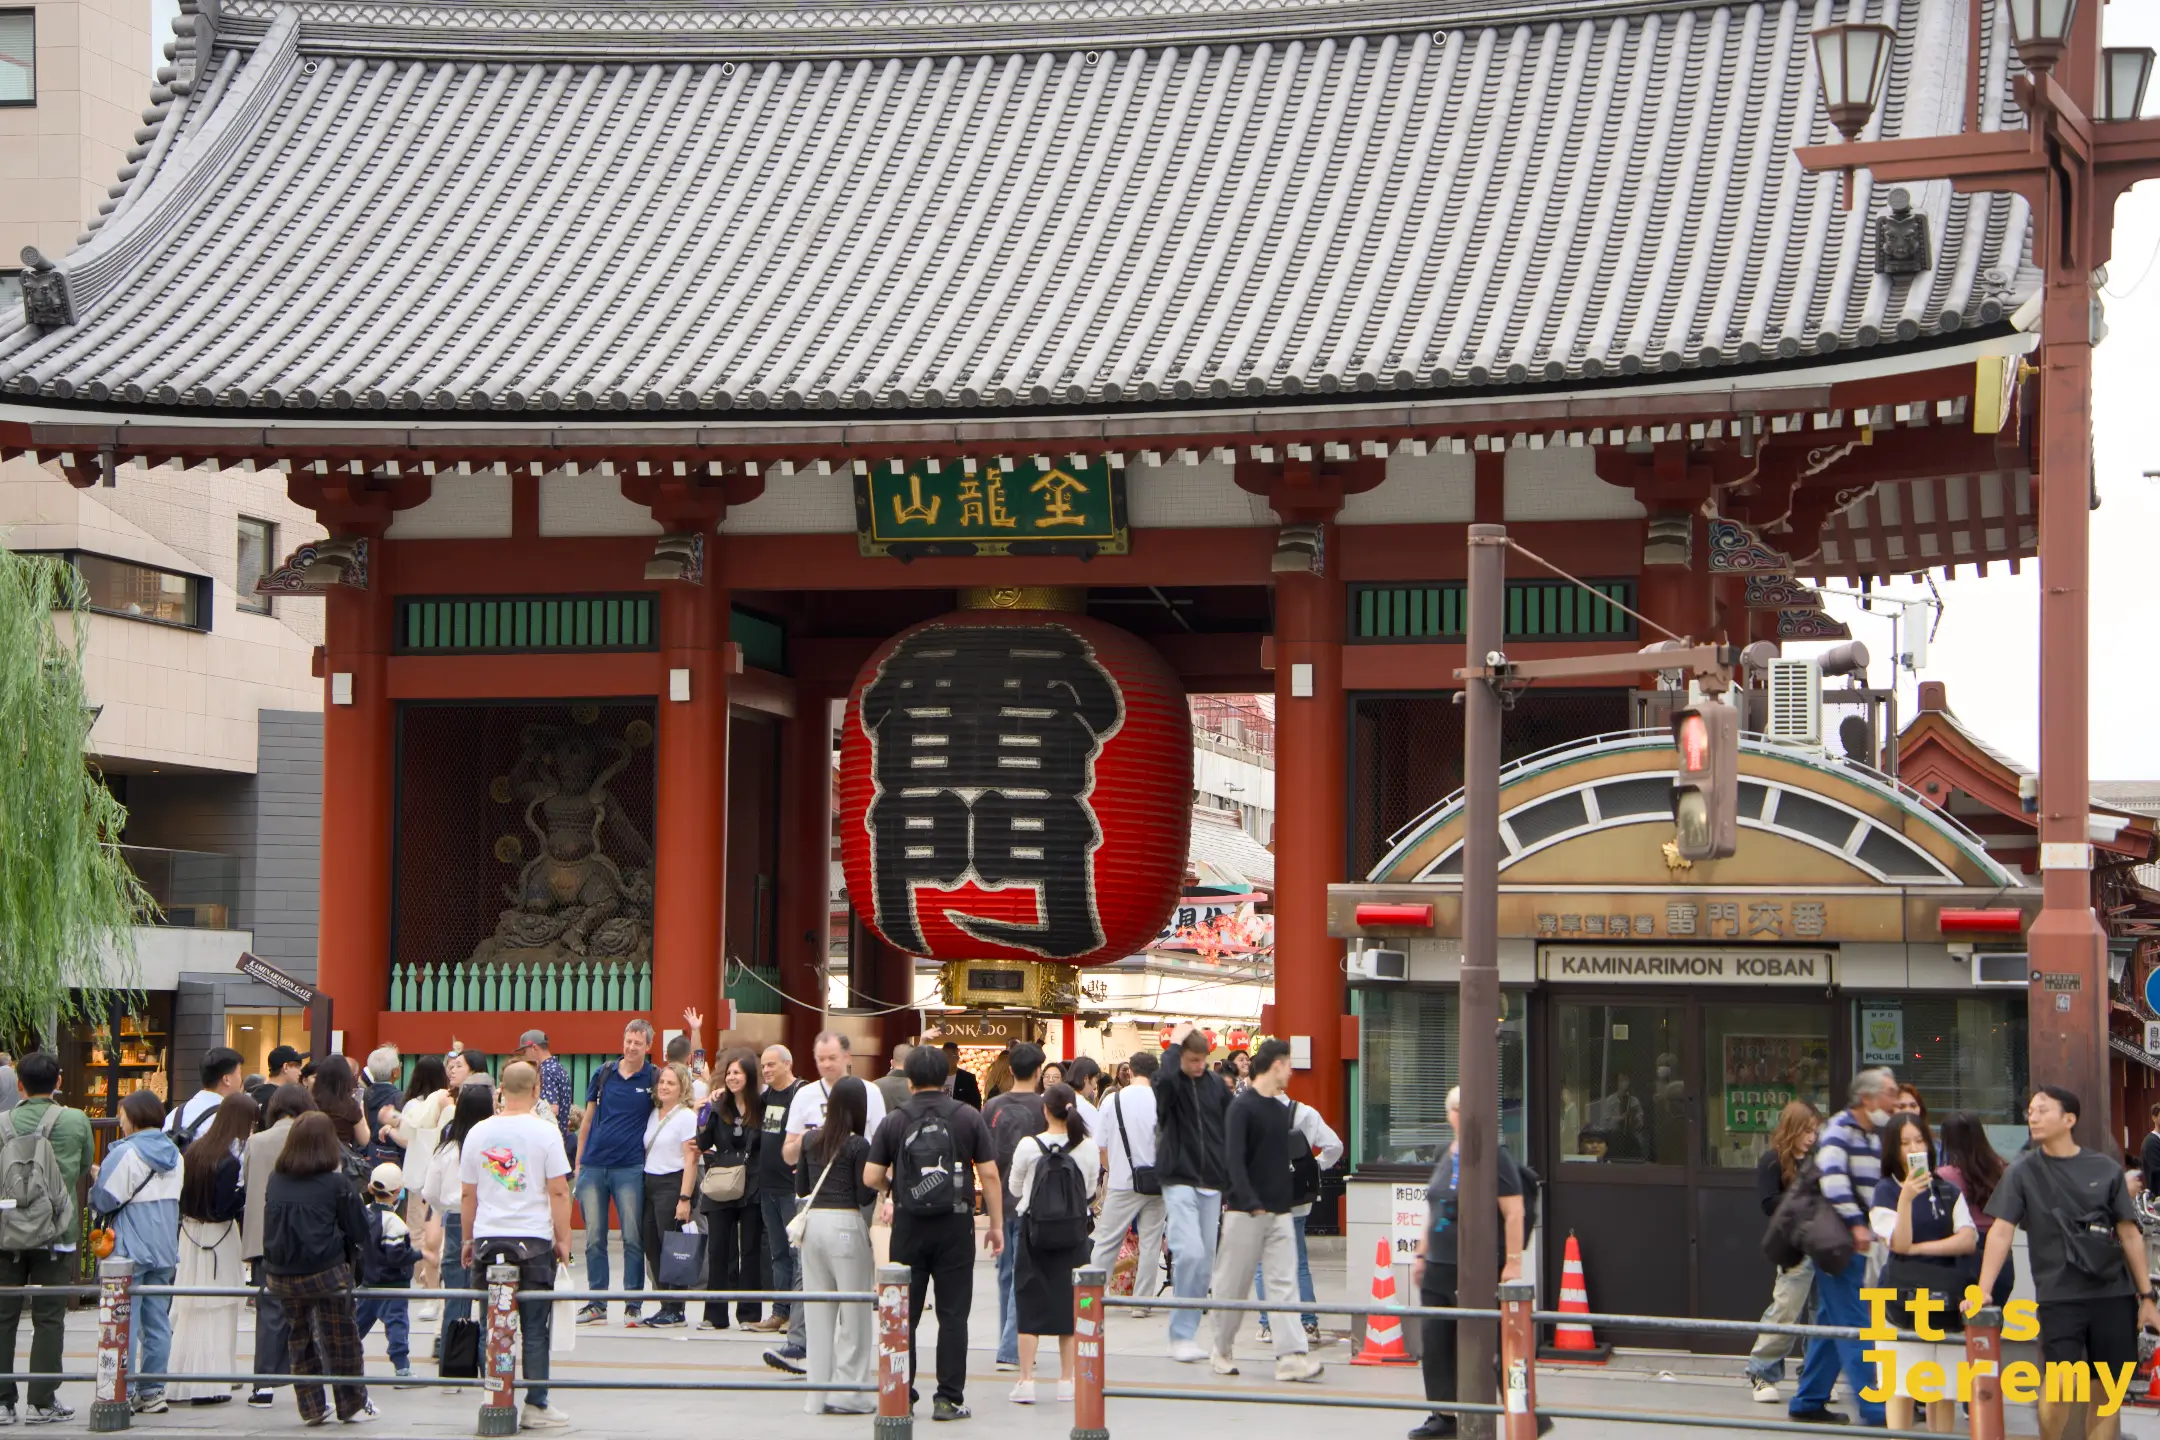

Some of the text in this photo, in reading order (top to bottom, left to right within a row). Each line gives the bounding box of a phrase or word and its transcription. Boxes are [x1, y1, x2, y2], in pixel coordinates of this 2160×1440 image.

[860, 623, 1125, 958] 雷門
[1666, 901, 1827, 936] 雷門交番
[1562, 957, 1814, 977] KAMINARIMON KOBAN
[248, 960, 295, 988] KAMINARIMON
[294, 985, 313, 999] GATE
[931, 1023, 1007, 1038] ONKADO
[1865, 1052, 1901, 1061] POLICE
[1396, 1211, 1422, 1227] 死亡
